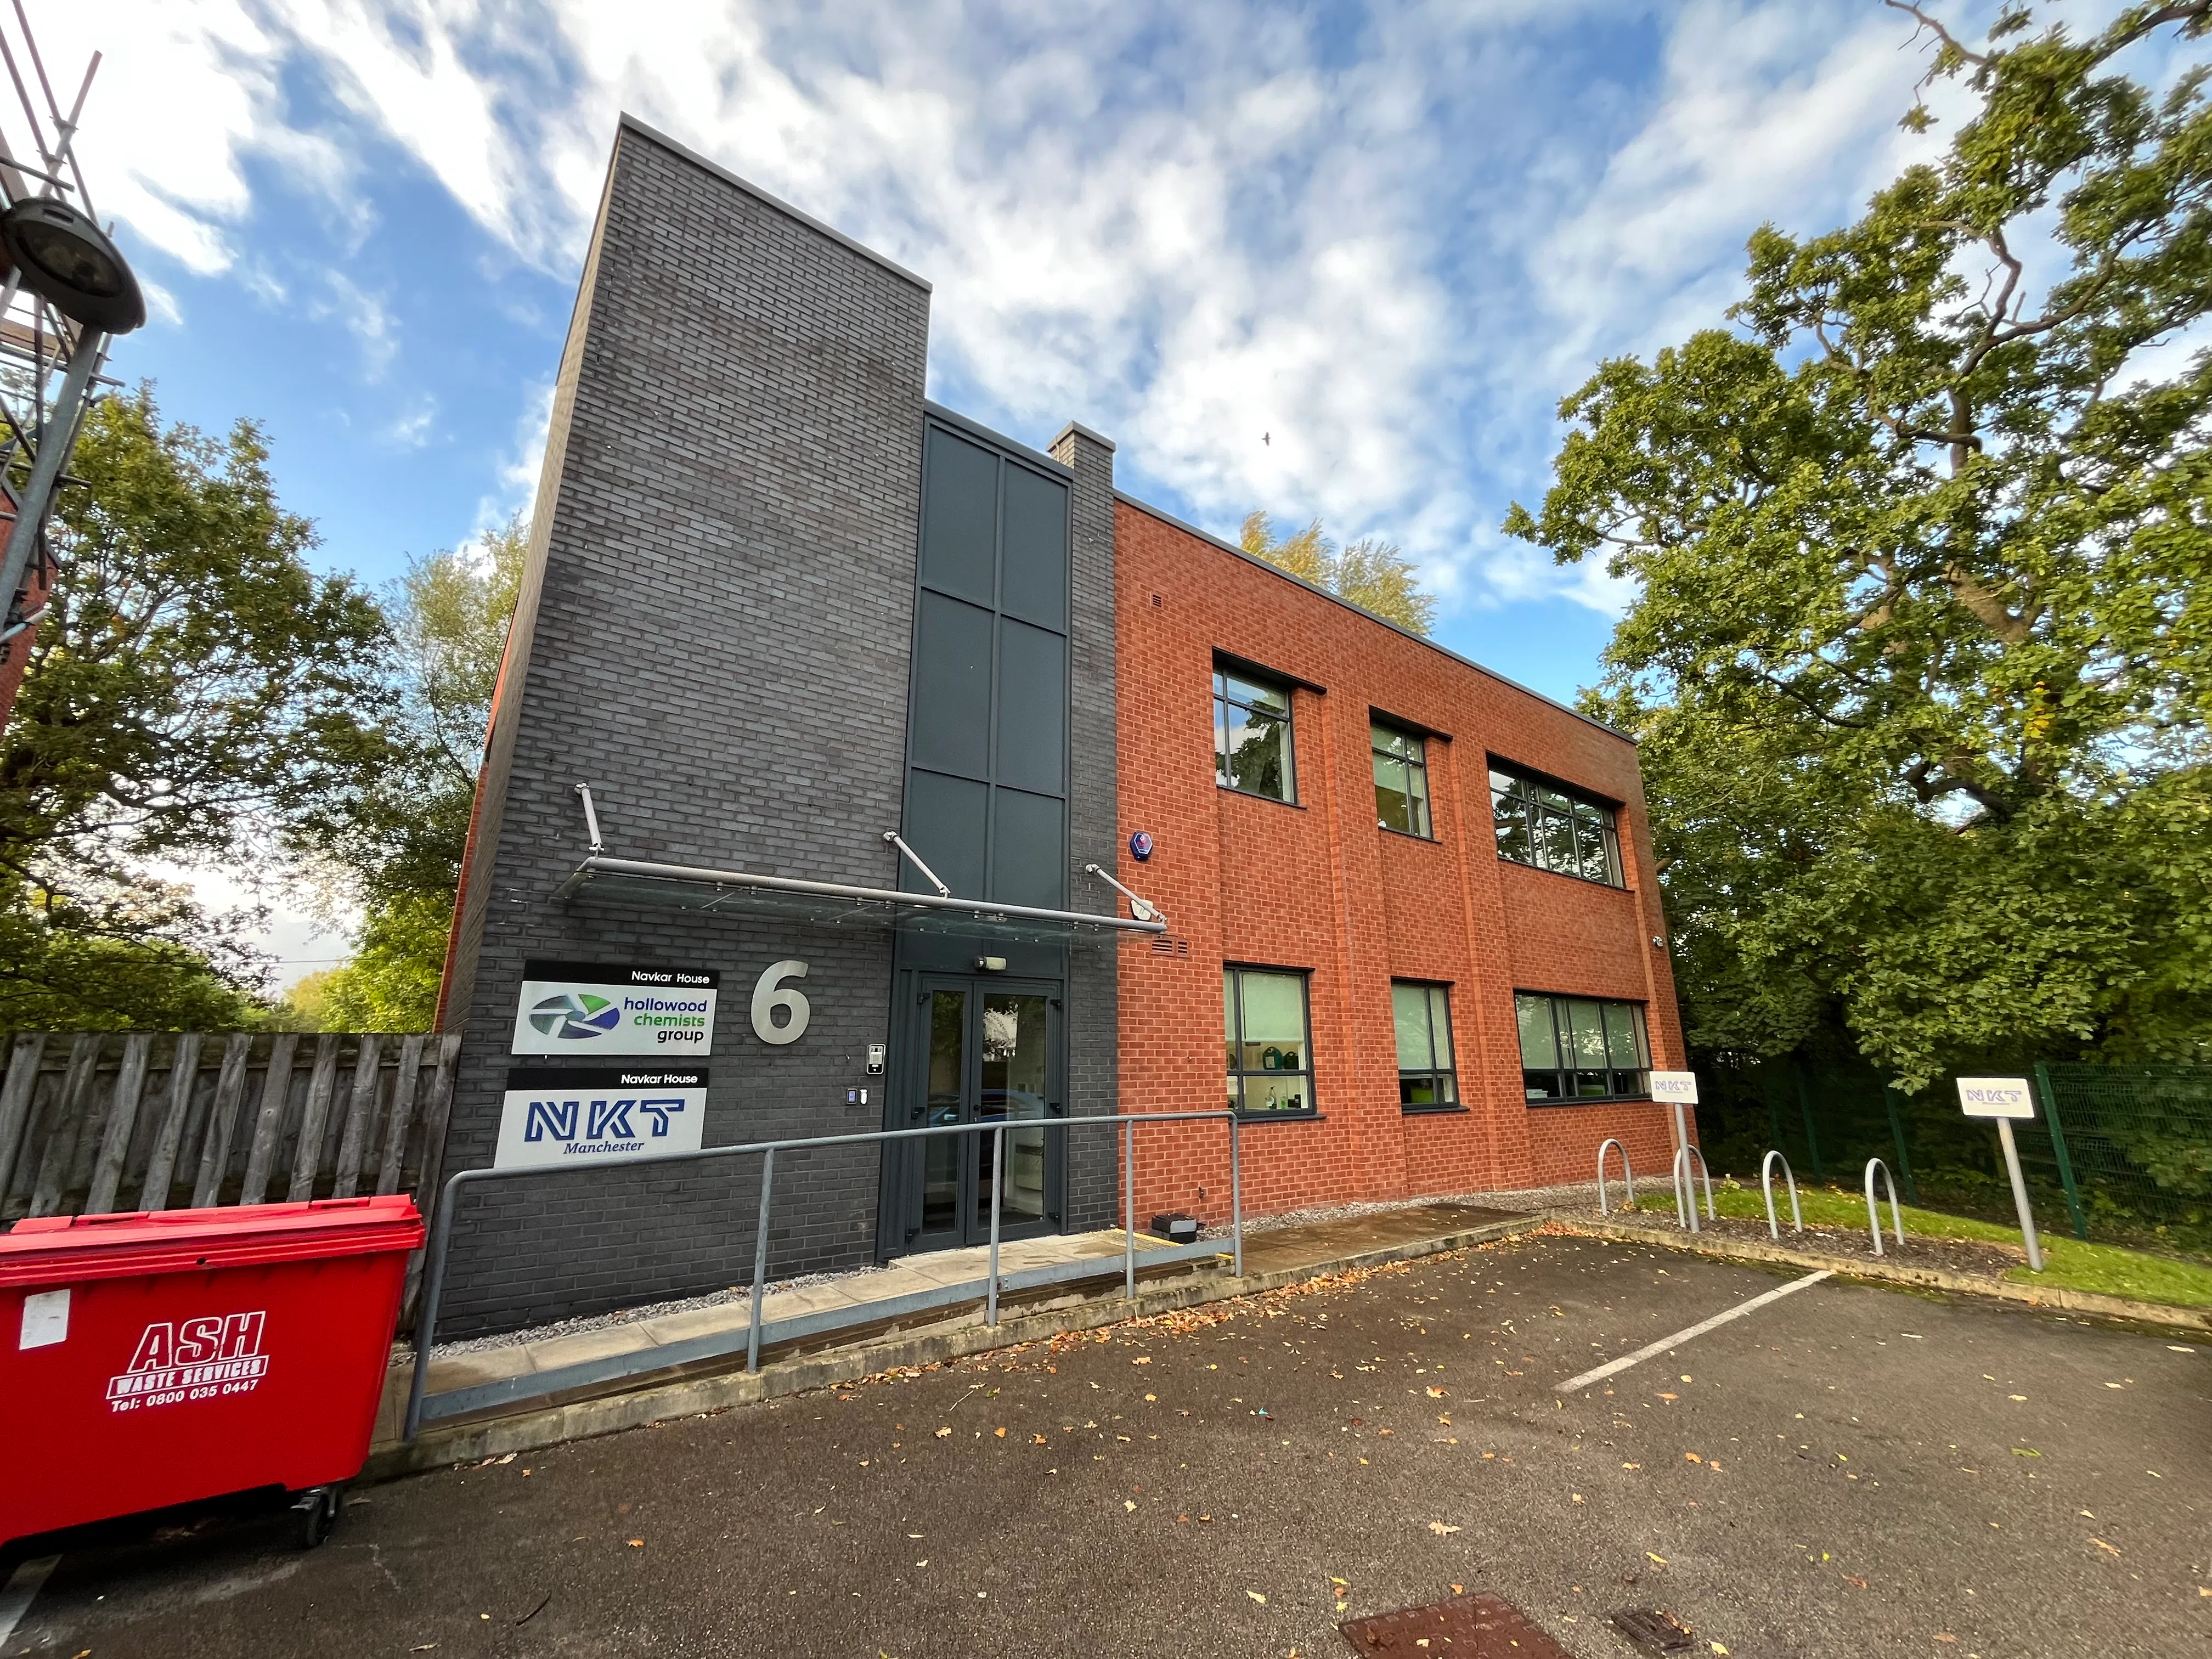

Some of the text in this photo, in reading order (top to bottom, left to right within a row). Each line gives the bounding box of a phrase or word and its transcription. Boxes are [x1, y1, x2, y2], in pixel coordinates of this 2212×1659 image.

[631, 970, 710, 984] Navkar House
[624, 997, 707, 1012] hollowood
[751, 960, 810, 1045] 6
[634, 1013, 705, 1026] chemists
[657, 1030, 704, 1043] group
[621, 1074, 698, 1084] Navkar House
[1655, 1080, 1691, 1091] NKT
[1966, 1090, 2022, 1102] NKT
[524, 1099, 685, 1142] NKT
[563, 1141, 645, 1154] Manchester
[127, 1311, 266, 1373] ASH
[116, 1359, 261, 1395] WASTE SERVICES
[111, 1379, 258, 1412] Tel: 0800 035 0447
